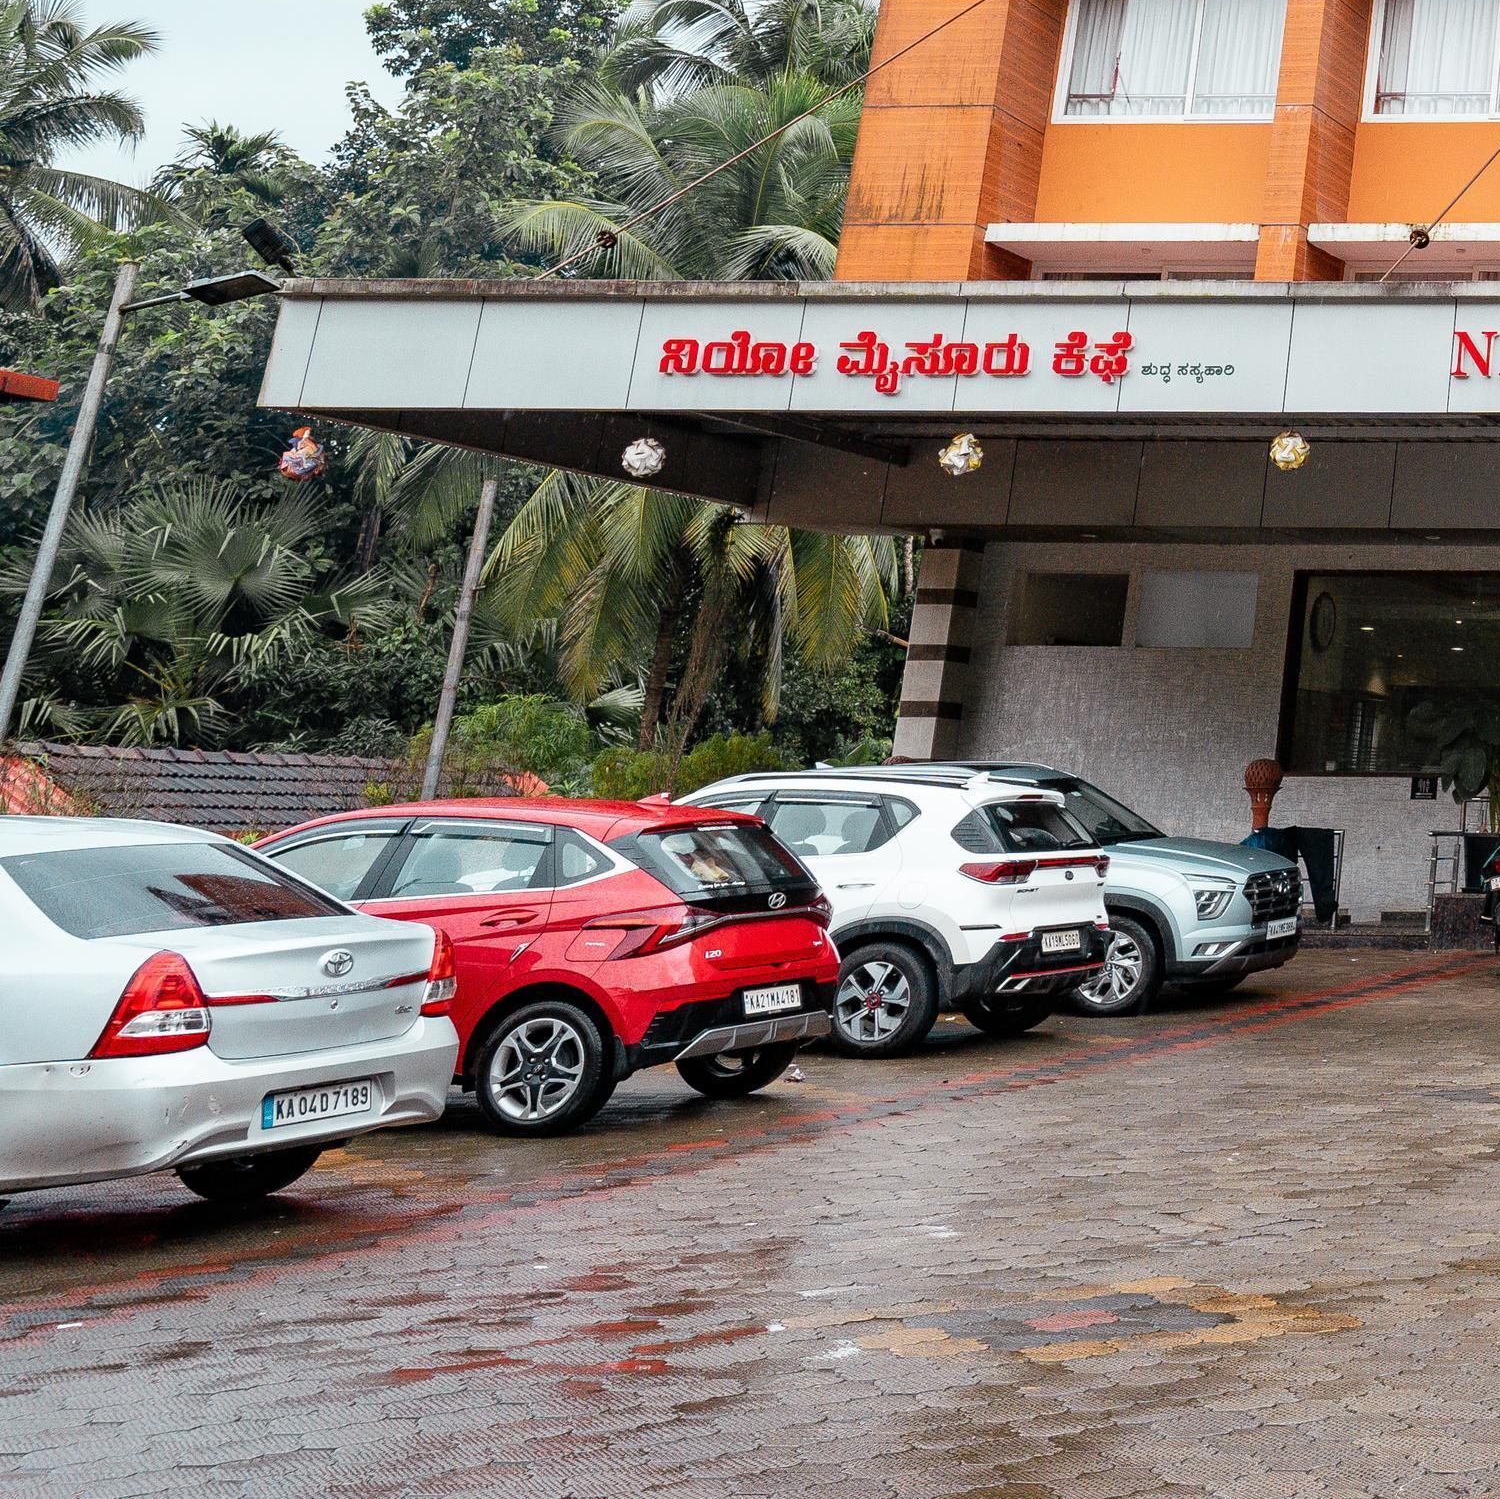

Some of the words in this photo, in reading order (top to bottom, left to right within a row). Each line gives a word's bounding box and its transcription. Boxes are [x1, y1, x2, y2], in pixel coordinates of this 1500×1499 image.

[659, 330, 819, 377] ನಿಯೋ
[836, 331, 1033, 395] ಮೈಸೂರು
[1141, 363, 1172, 383] ಶುದ್ಧ
[750, 989, 799, 1009] KA21MA4181
